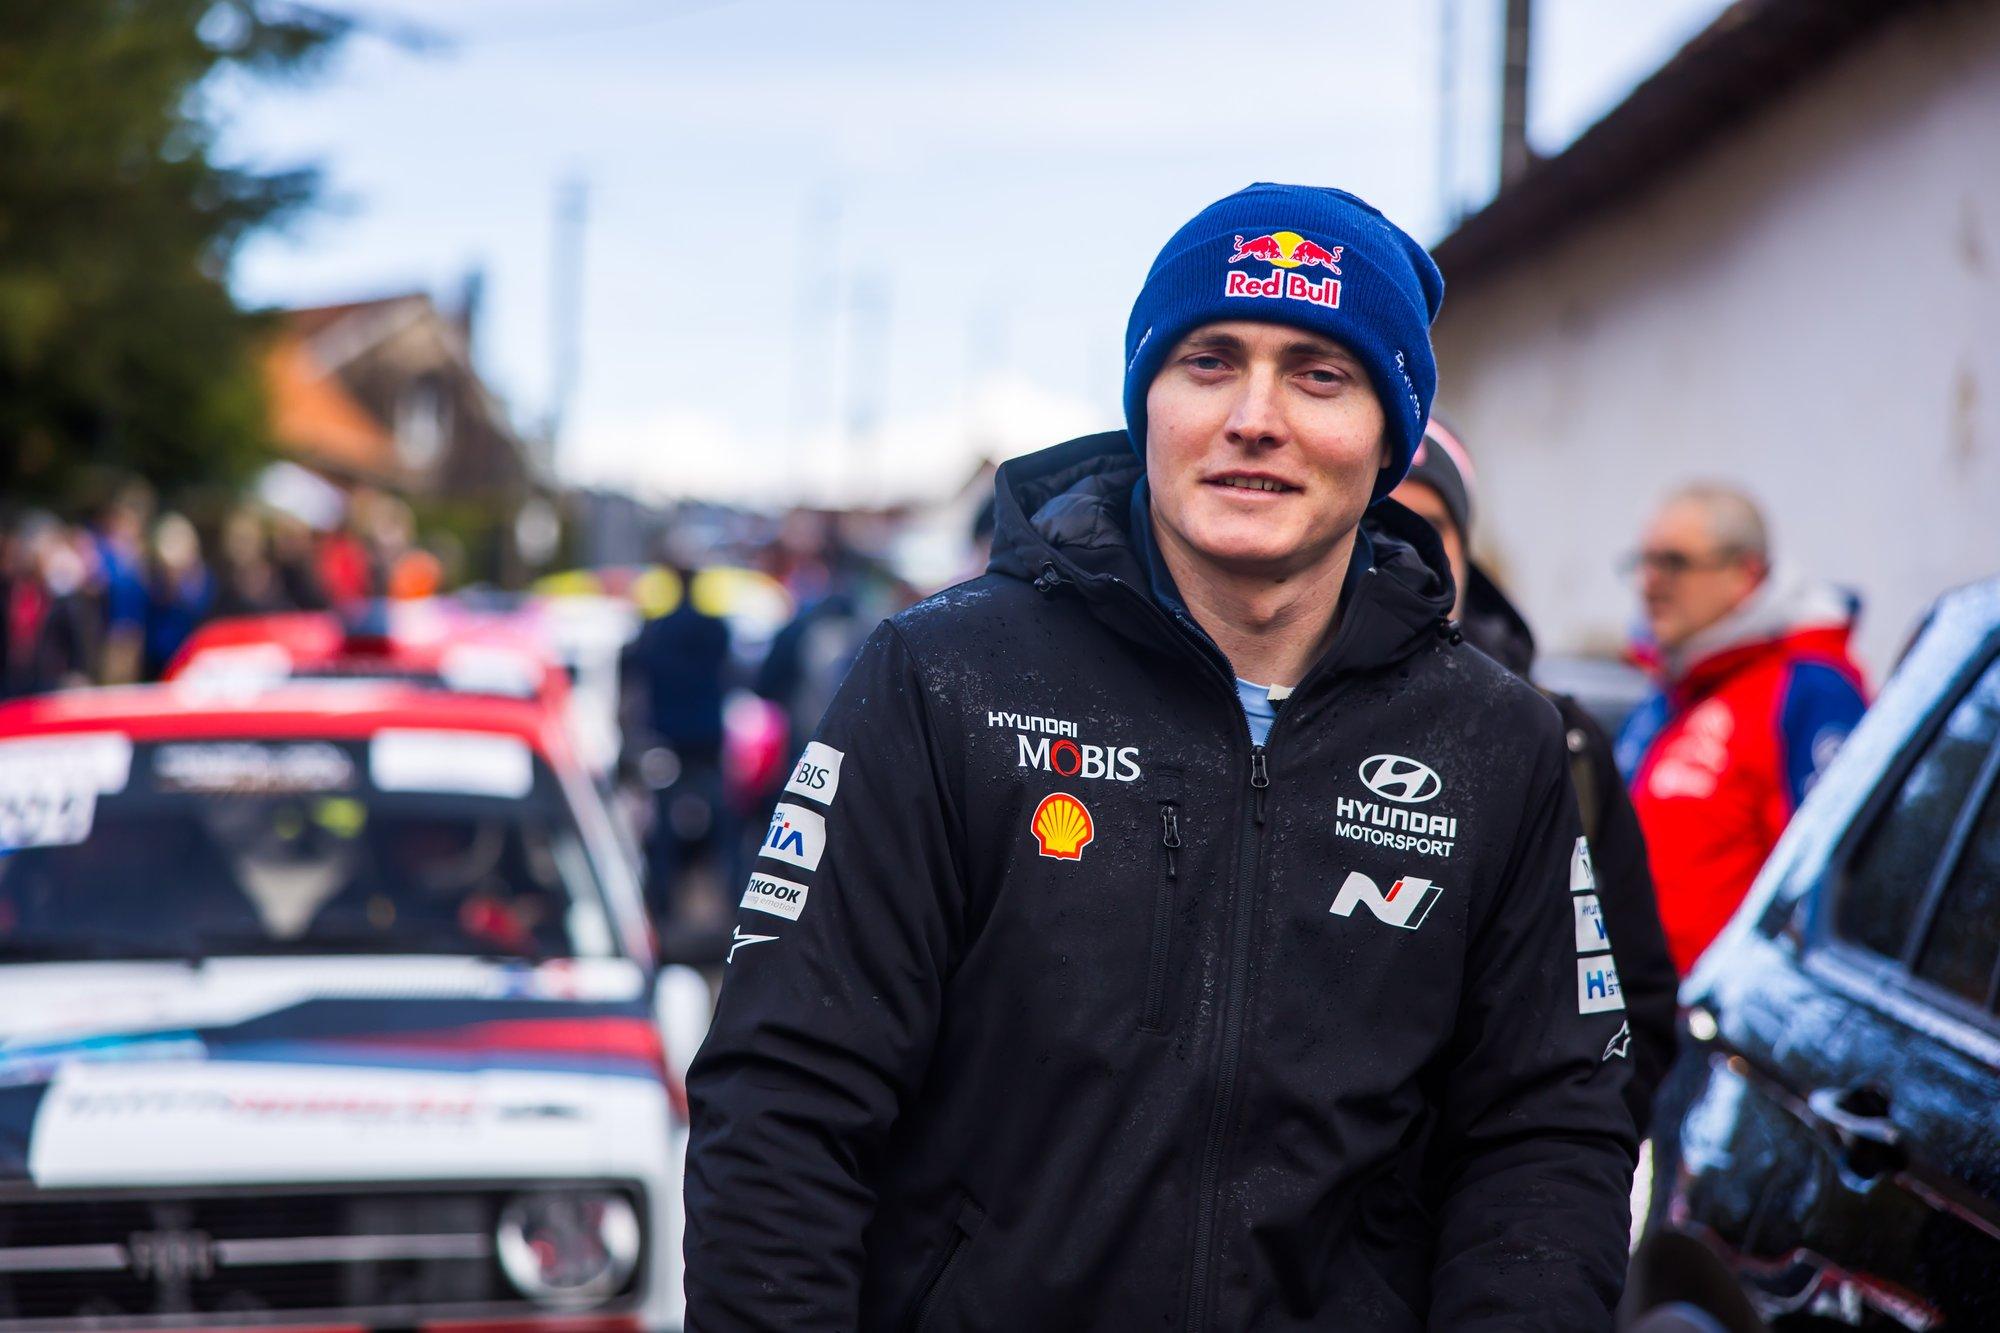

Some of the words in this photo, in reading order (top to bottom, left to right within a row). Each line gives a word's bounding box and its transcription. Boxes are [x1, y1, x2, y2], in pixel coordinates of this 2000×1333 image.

[1226, 270, 1283, 297] Red
[1287, 273, 1340, 307] Bull
[988, 711, 1078, 738] HYUNDAI
[1016, 734, 1142, 782] MOBIS
[1336, 796, 1457, 838] HYUNDAI
[1335, 821, 1455, 858] MOTORSPORT
